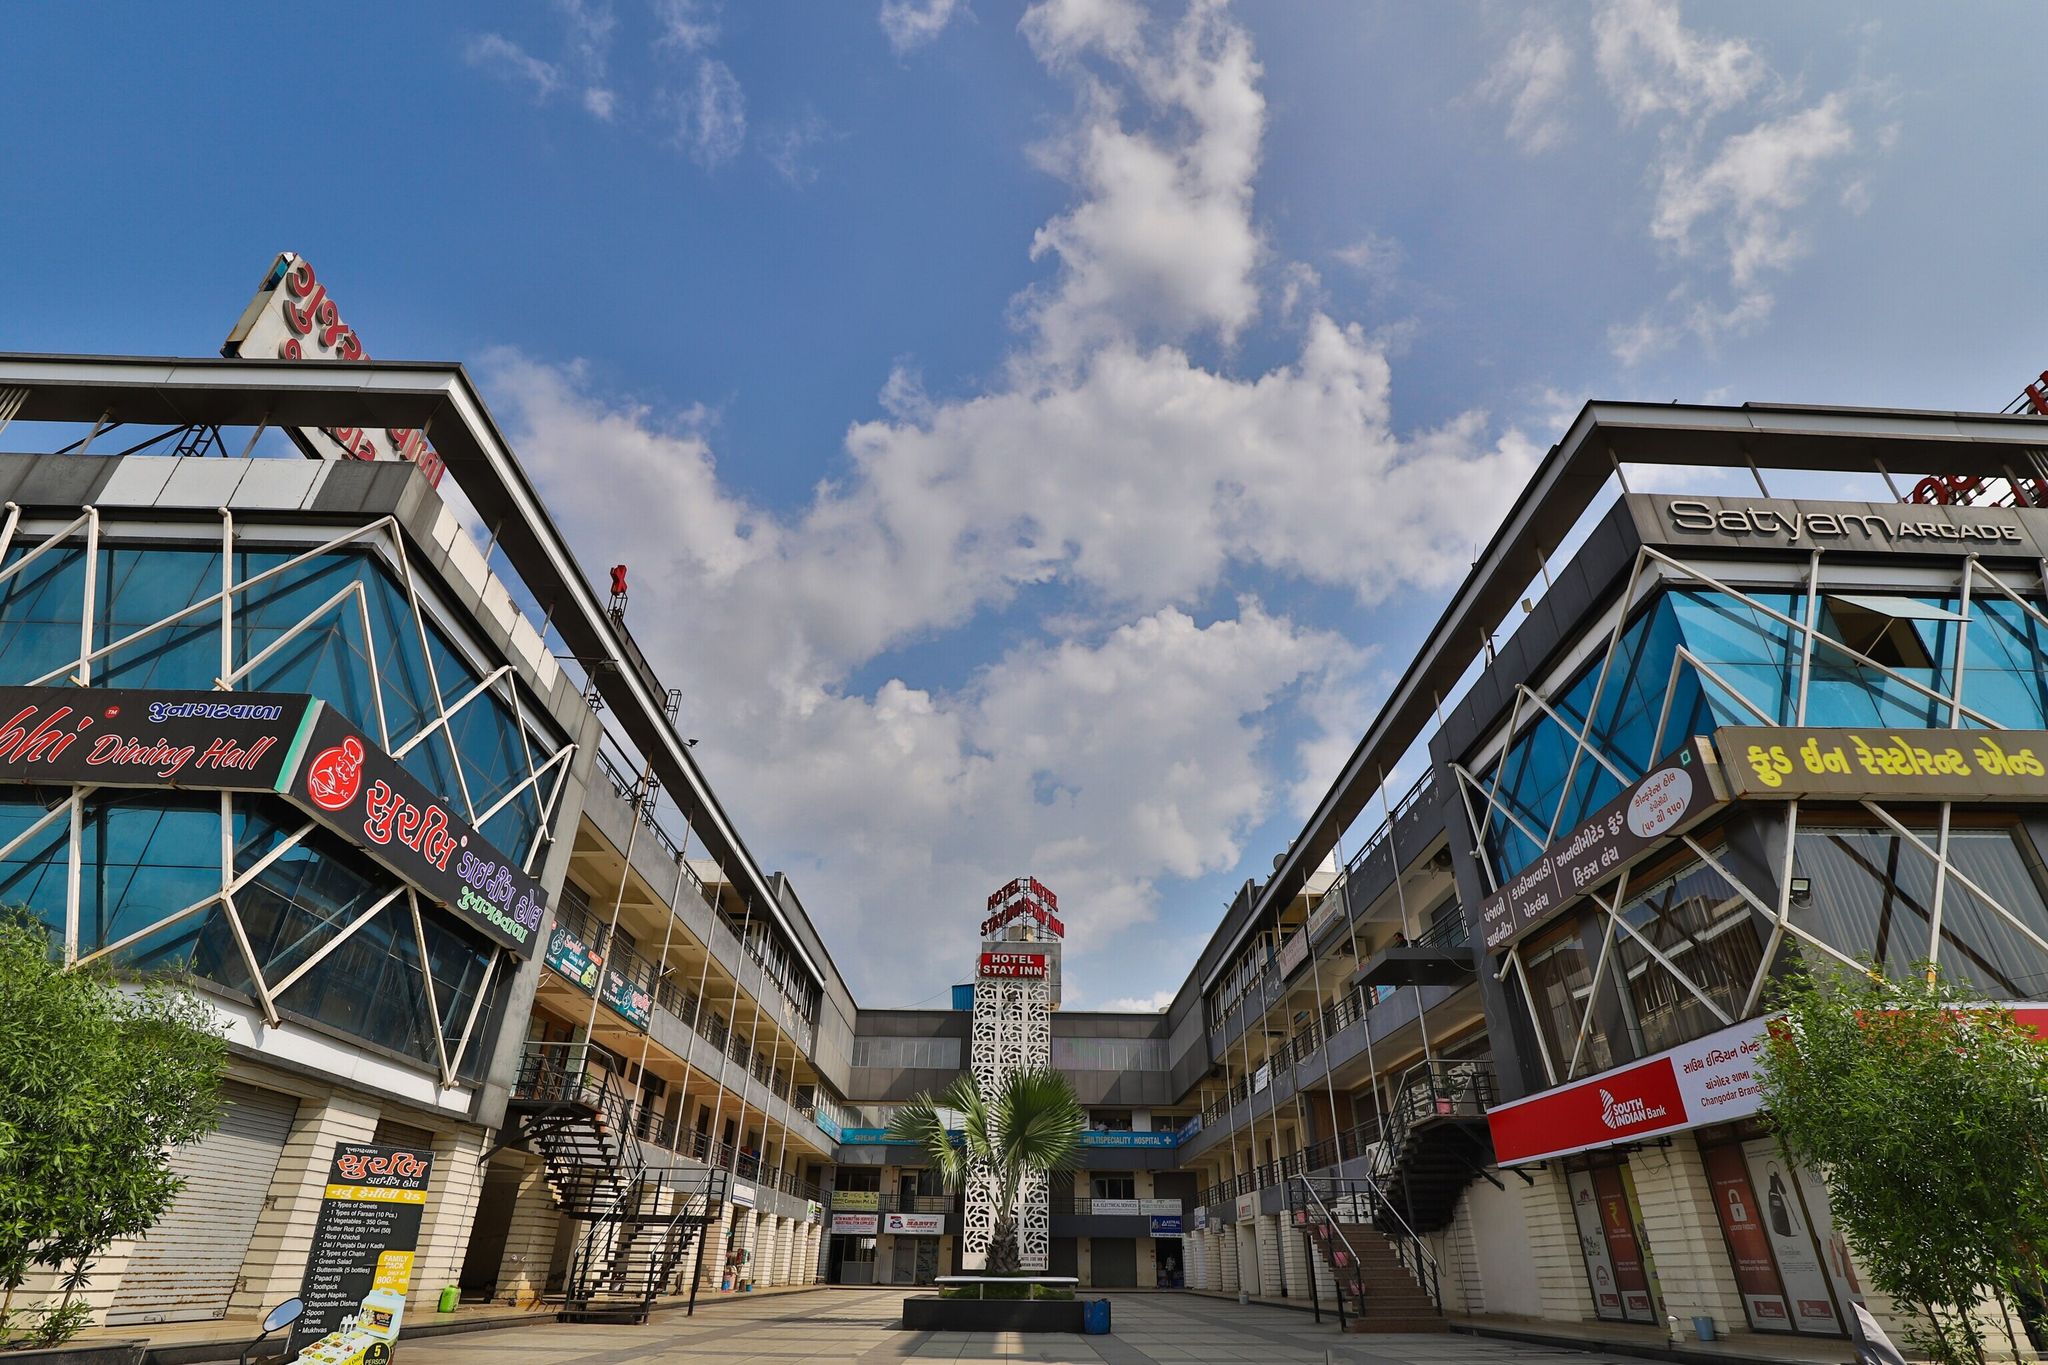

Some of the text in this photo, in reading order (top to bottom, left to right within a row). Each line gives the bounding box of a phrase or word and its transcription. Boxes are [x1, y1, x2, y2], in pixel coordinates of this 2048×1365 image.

[1669, 500, 2023, 541] Satyam ARCADE
[86, 734, 278, 777] Dining Hall
[1848, 735, 1971, 776] રેસ્ટોરન્ટ
[1662, 772, 1676, 787] હોલ
[364, 779, 458, 872] સુરભિ
[1601, 846, 1620, 867] લંચ
[1511, 858, 1552, 900] કાઠીયાવાડી
[987, 878, 1020, 911] HOTEL
[1030, 876, 1058, 912] HOTEL
[514, 888, 543, 932] હોલ
[1025, 897, 1064, 938] STAY INN
[1484, 896, 1506, 923] પંજાબી
[981, 908, 1007, 936] STAY
[983, 965, 1042, 976] STAY INN
[992, 955, 1034, 964] HOTEL
[1683, 1058, 1704, 1074] સાઉથ
[1705, 1070, 1750, 1090] ચાંગોદર શાખા
[1613, 1098, 1643, 1115] SOUTH
[1701, 1084, 1765, 1107] Changodar Branch
[1615, 1104, 1667, 1127] INDIAN Bank
[1133, 1136, 1161, 1145] HOSPITAL
[337, 1152, 428, 1179] સુરભિ
[402, 1178, 419, 1188] હોલ
[333, 1217, 361, 1225] Vegetables
[384, 1255, 409, 1263] FAMILY
[308, 1300, 339, 1308] Disposable
[374, 1345, 381, 1357] 5
